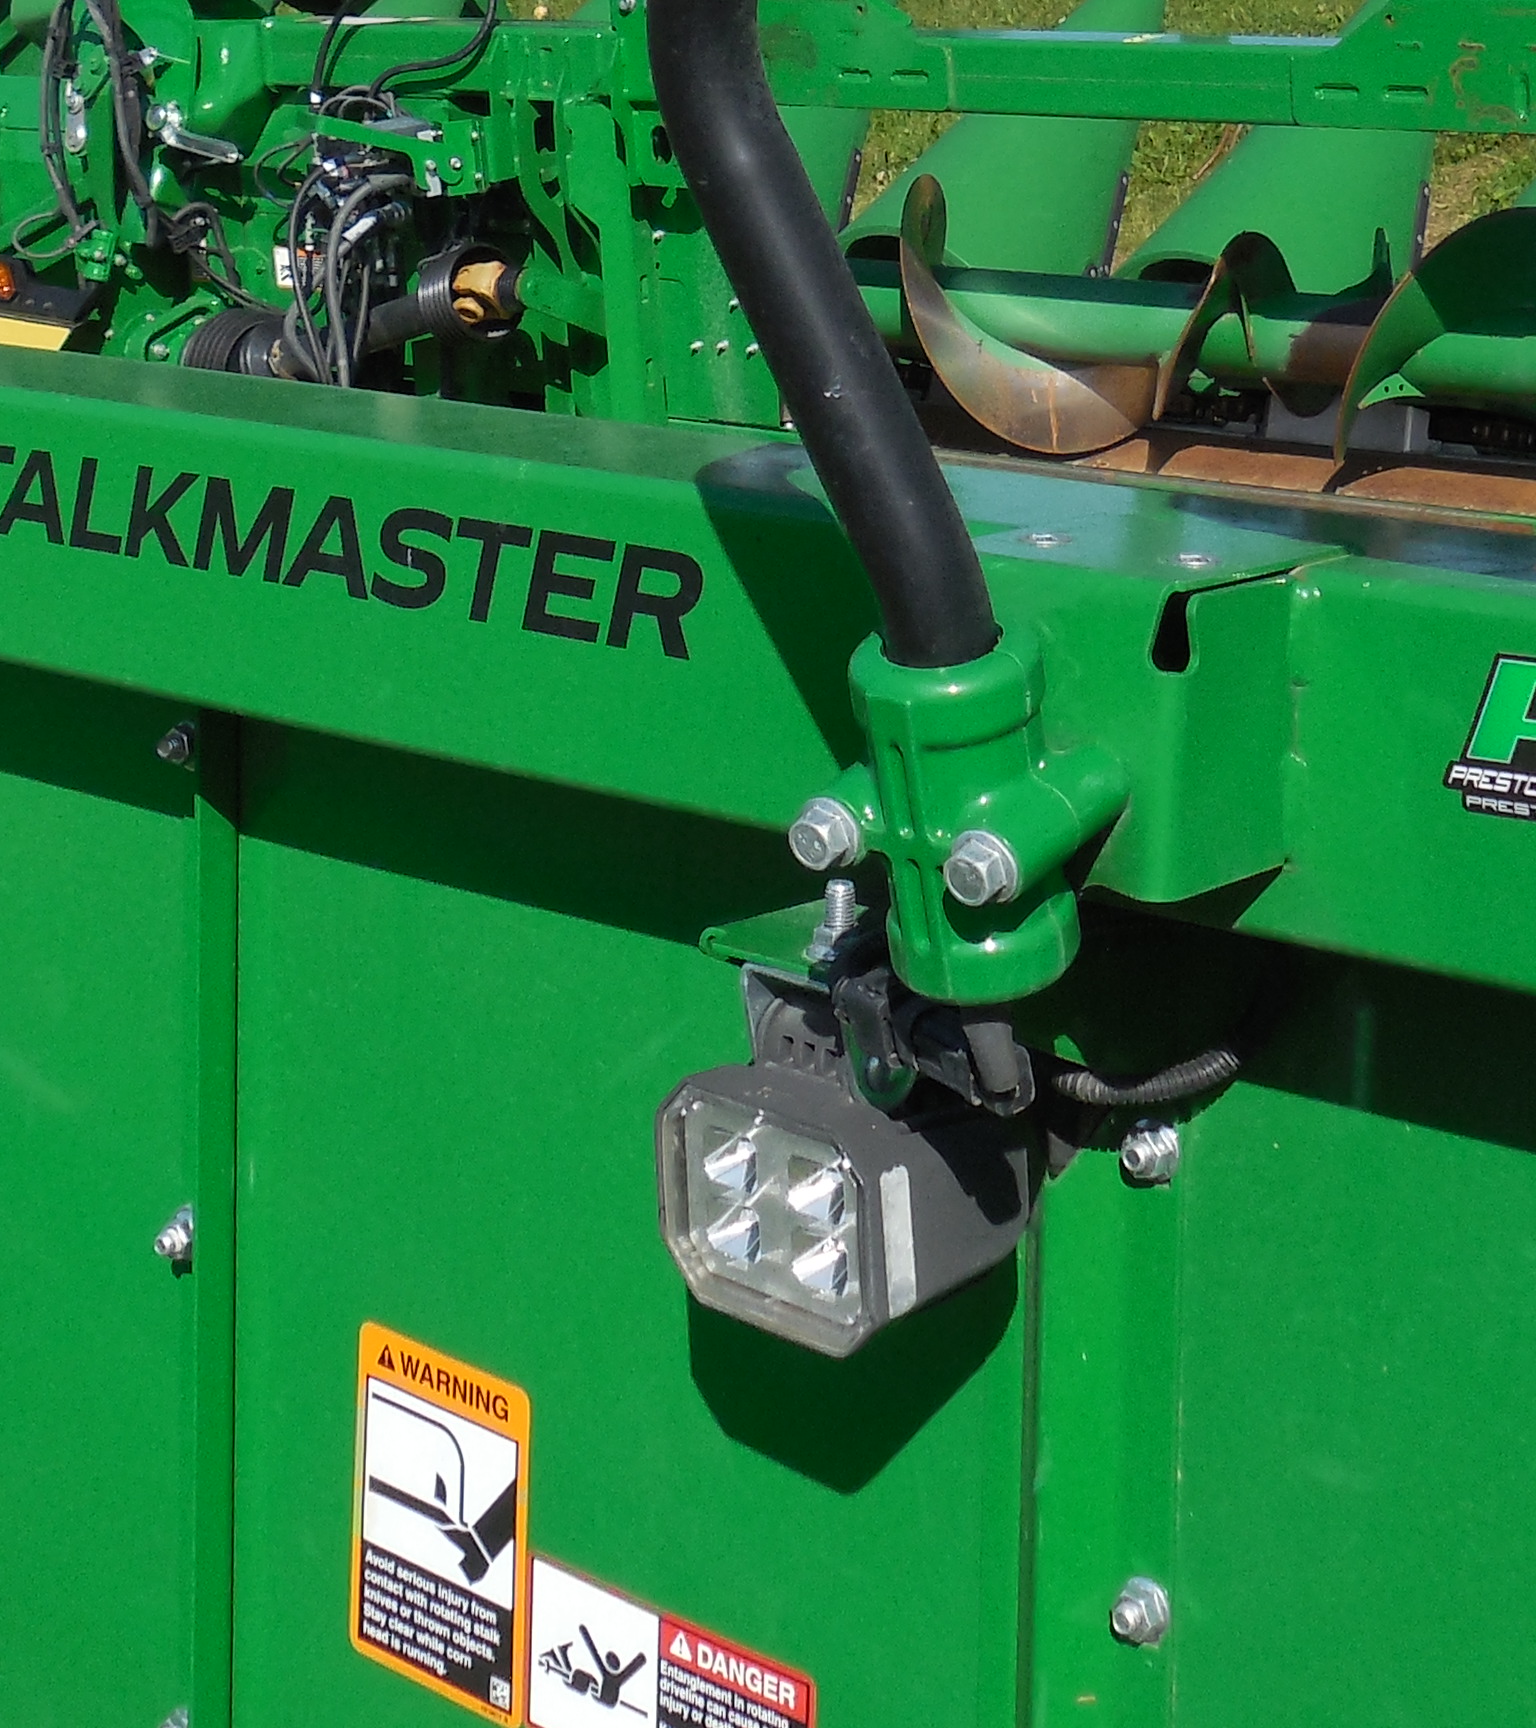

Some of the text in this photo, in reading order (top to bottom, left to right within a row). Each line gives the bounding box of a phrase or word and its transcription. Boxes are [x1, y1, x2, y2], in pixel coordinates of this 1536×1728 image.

[400, 1351, 508, 1422] WARNING
[364, 1569, 500, 1646] contact with rotating stalk
[365, 1549, 497, 1625] Avoid serious injury from
[363, 1602, 472, 1669] Stay clear while corn
[363, 1620, 447, 1676] head is running.
[364, 1584, 495, 1663] knives or thrown objects.
[659, 1676, 760, 1728] driveline can cause
[659, 1690, 690, 1721] injury
[691, 1706, 703, 1722] or
[660, 1659, 789, 1728] Entanglement in rotating
[697, 1642, 795, 1710] DANGER
